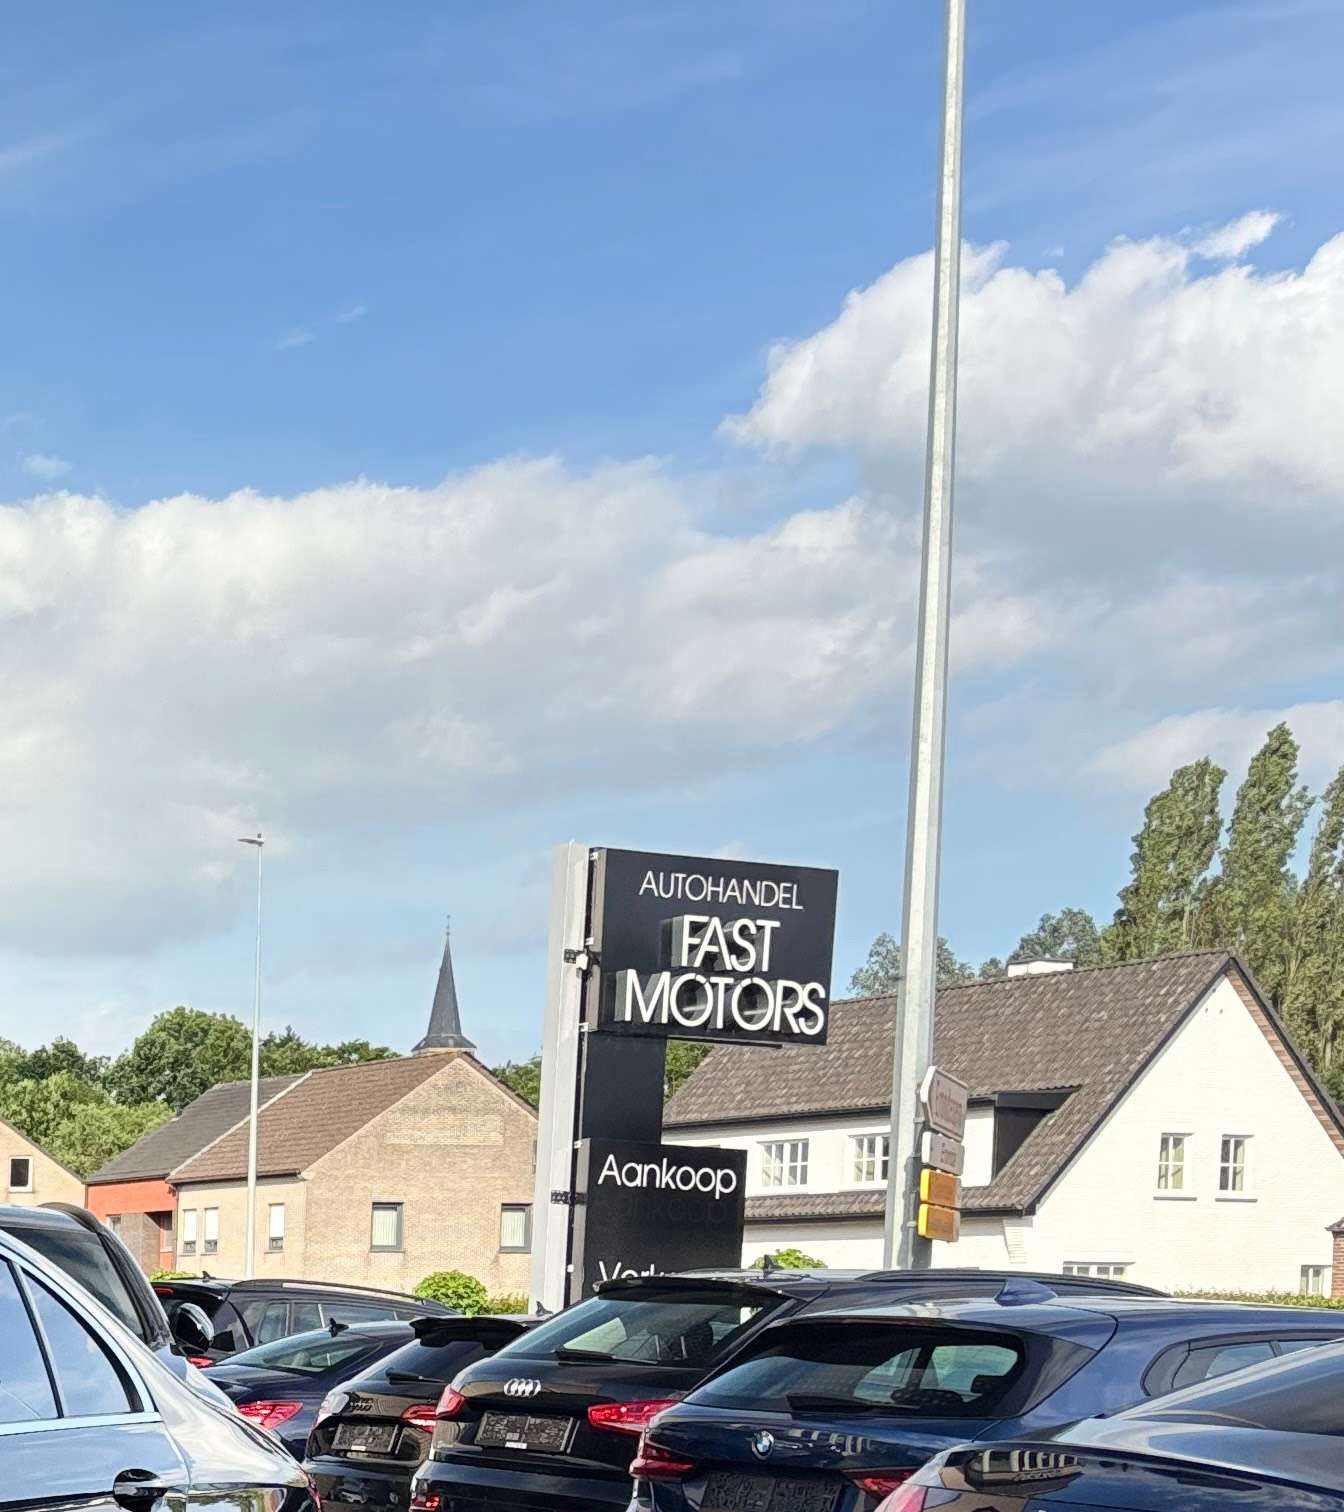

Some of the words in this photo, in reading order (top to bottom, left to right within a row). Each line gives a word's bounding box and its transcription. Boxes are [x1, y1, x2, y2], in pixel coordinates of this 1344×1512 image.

[639, 870, 803, 910] AUTOHANDEL
[681, 915, 781, 972] FAST
[624, 969, 825, 1035] MOTORS
[597, 1154, 737, 1200] Aankoop
